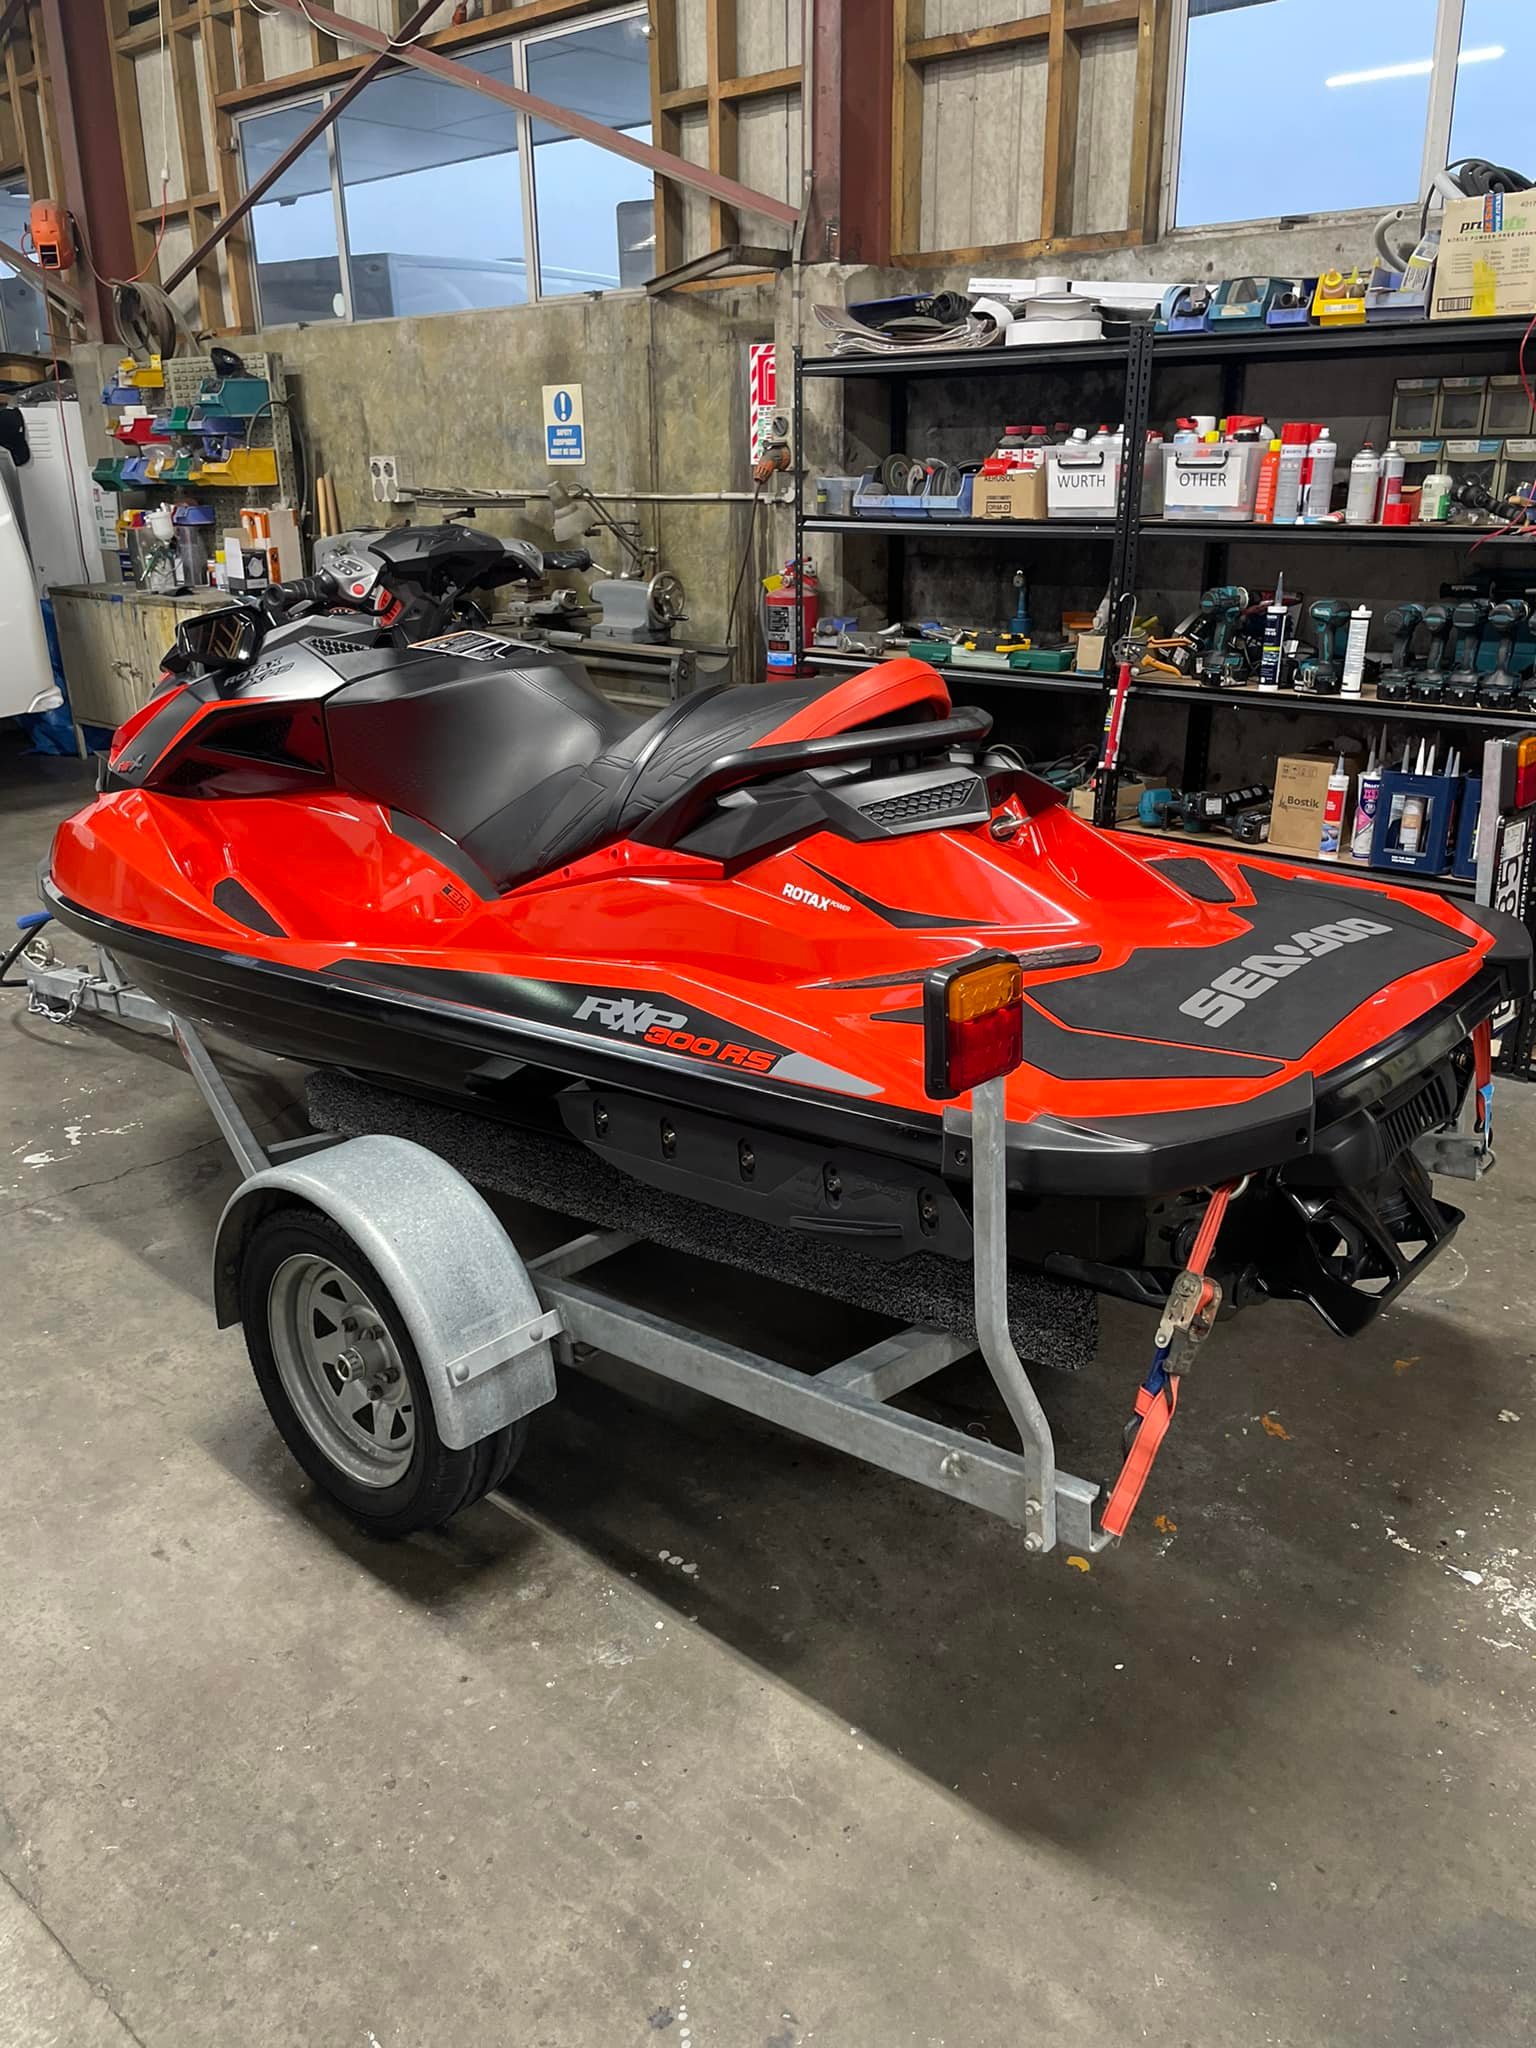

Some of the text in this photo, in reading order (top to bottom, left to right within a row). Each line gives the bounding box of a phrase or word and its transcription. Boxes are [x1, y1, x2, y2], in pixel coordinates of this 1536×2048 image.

[1057, 474, 1106, 488] WURTH
[1179, 472, 1226, 487] OTHER
[1287, 795, 1320, 809] Bostik
[782, 882, 852, 913] ROTAX POWER
[572, 995, 689, 1035] RXP
[643, 1026, 777, 1072] 300 RS
